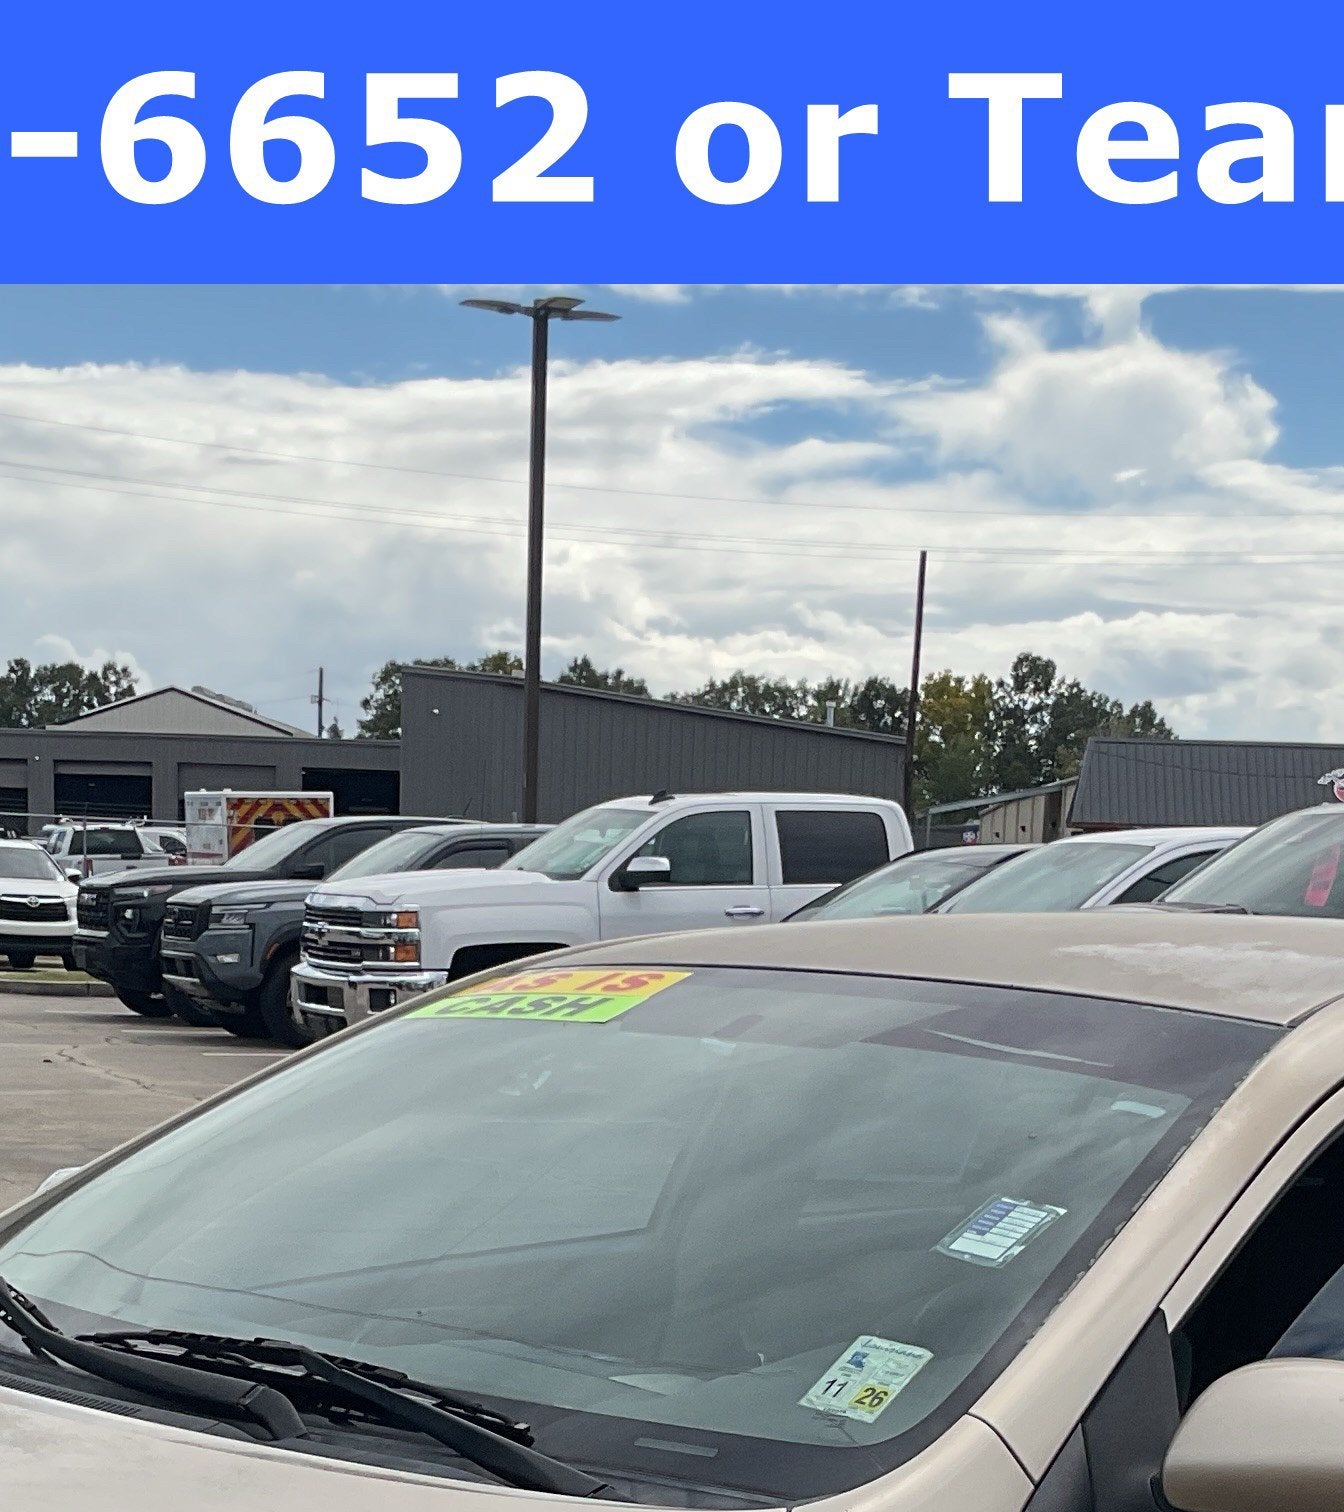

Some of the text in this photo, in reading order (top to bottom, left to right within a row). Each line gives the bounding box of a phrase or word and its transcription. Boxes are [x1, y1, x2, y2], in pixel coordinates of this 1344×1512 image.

[573, 971, 666, 993] IS
[434, 995, 615, 1018] CASH
[821, 1377, 889, 1408] 11 26
